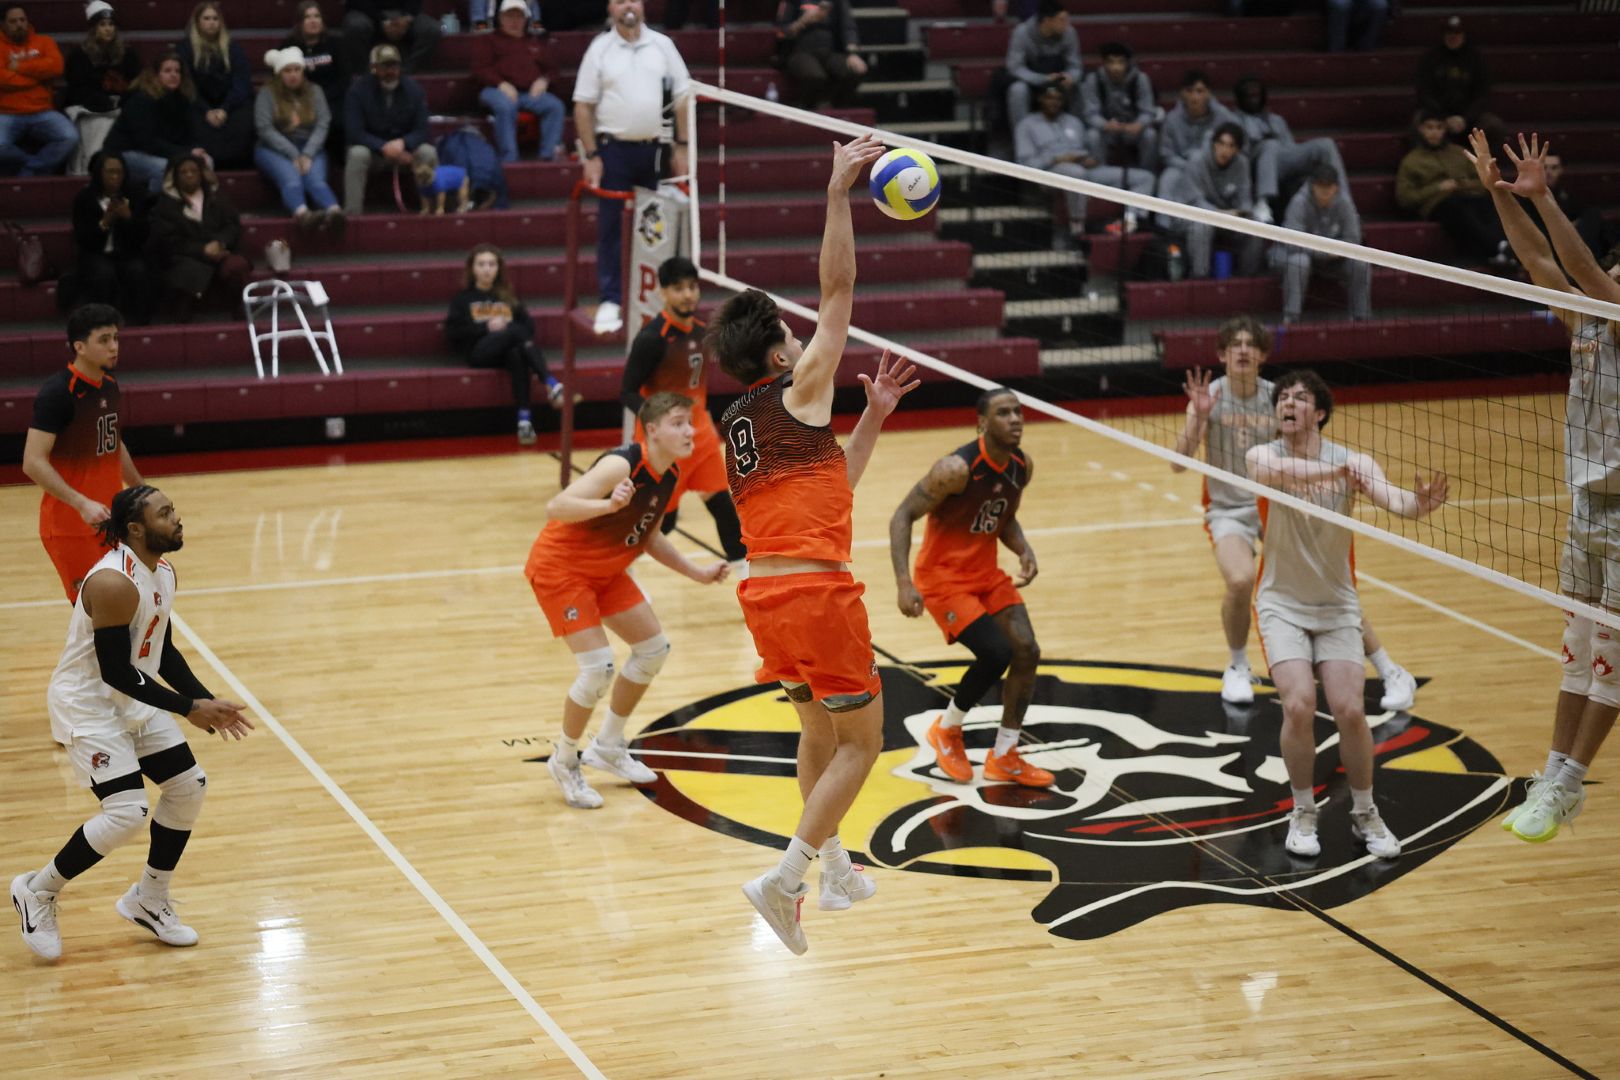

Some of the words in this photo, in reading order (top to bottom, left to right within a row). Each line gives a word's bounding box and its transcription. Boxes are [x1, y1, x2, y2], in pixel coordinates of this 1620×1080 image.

[687, 353, 704, 390] 7
[96, 412, 118, 456] 15
[728, 416, 760, 478] 9
[969, 497, 1009, 534] 19
[138, 614, 159, 659] 2
